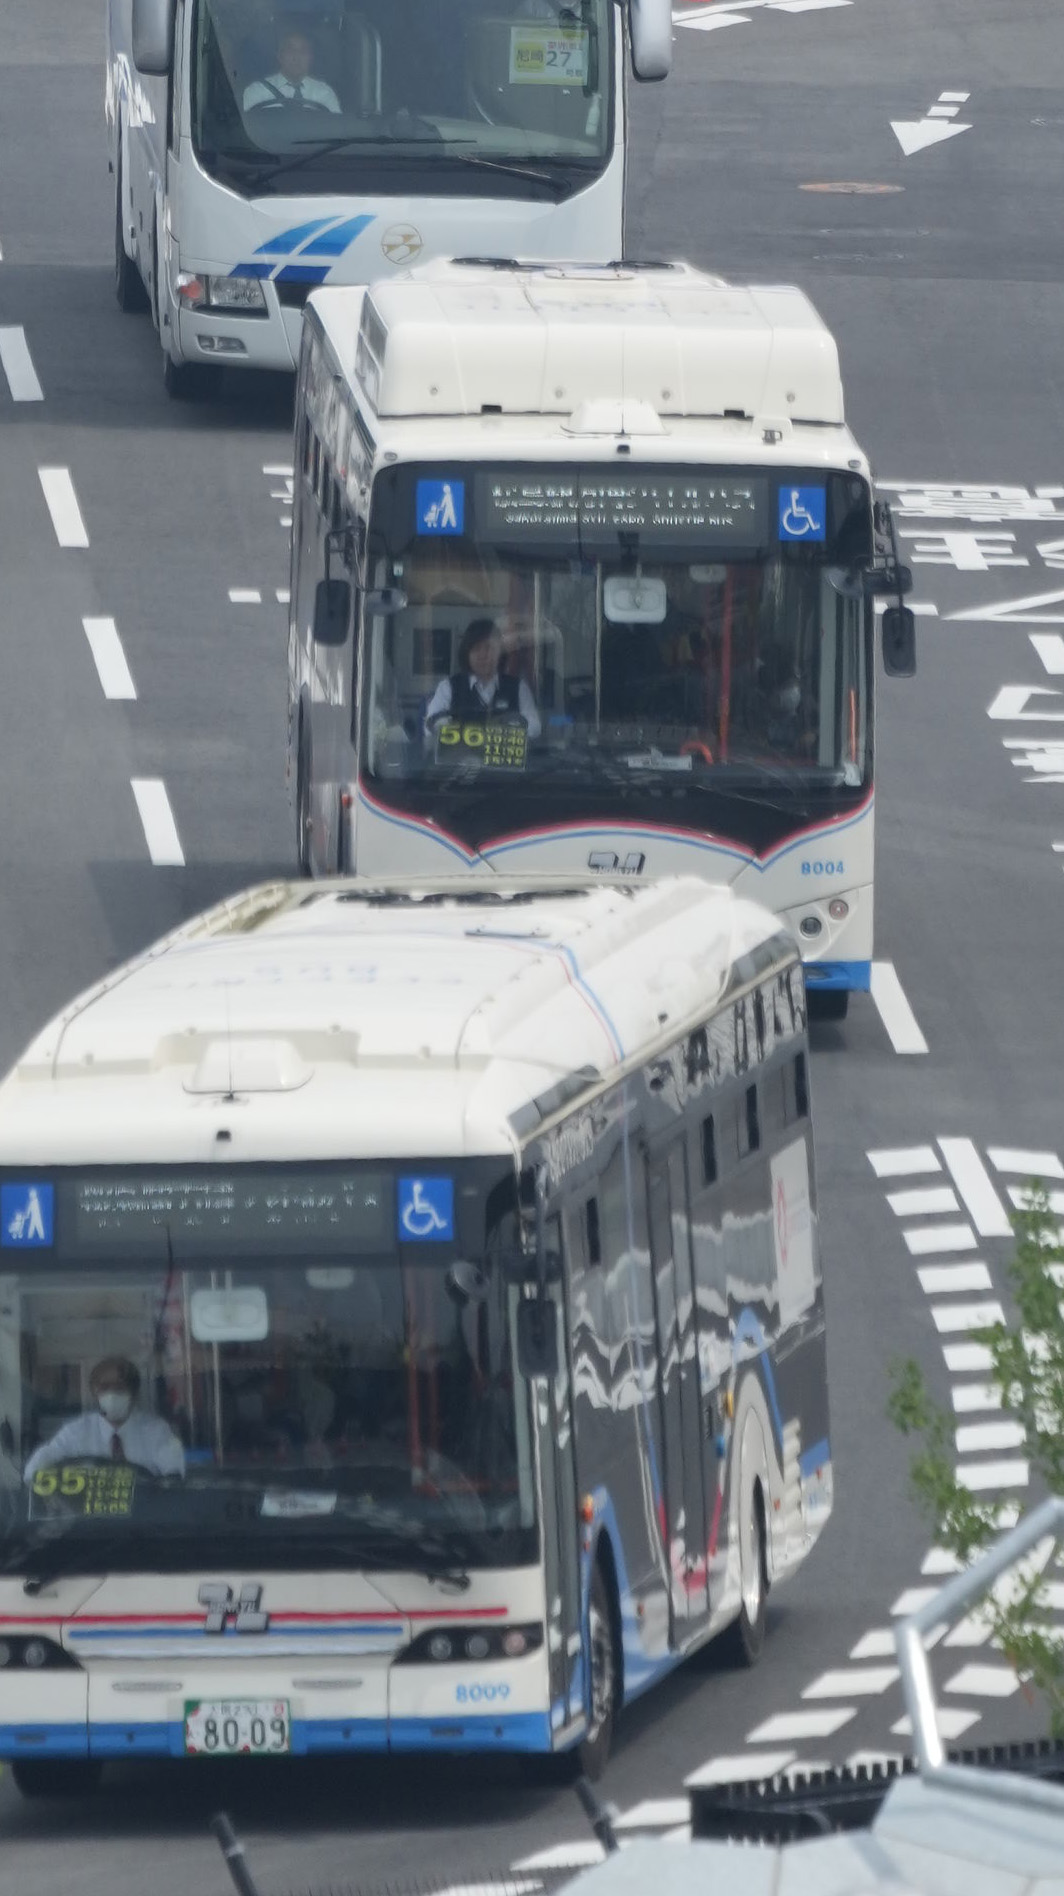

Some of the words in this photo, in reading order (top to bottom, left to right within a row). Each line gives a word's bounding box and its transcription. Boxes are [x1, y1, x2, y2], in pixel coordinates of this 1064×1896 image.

[546, 50, 572, 67] 27
[439, 724, 484, 747] 56
[801, 861, 844, 875] 8004
[32, 1466, 86, 1496] 55
[456, 1682, 511, 1703] 8009
[204, 1716, 286, 1750] 80-09
